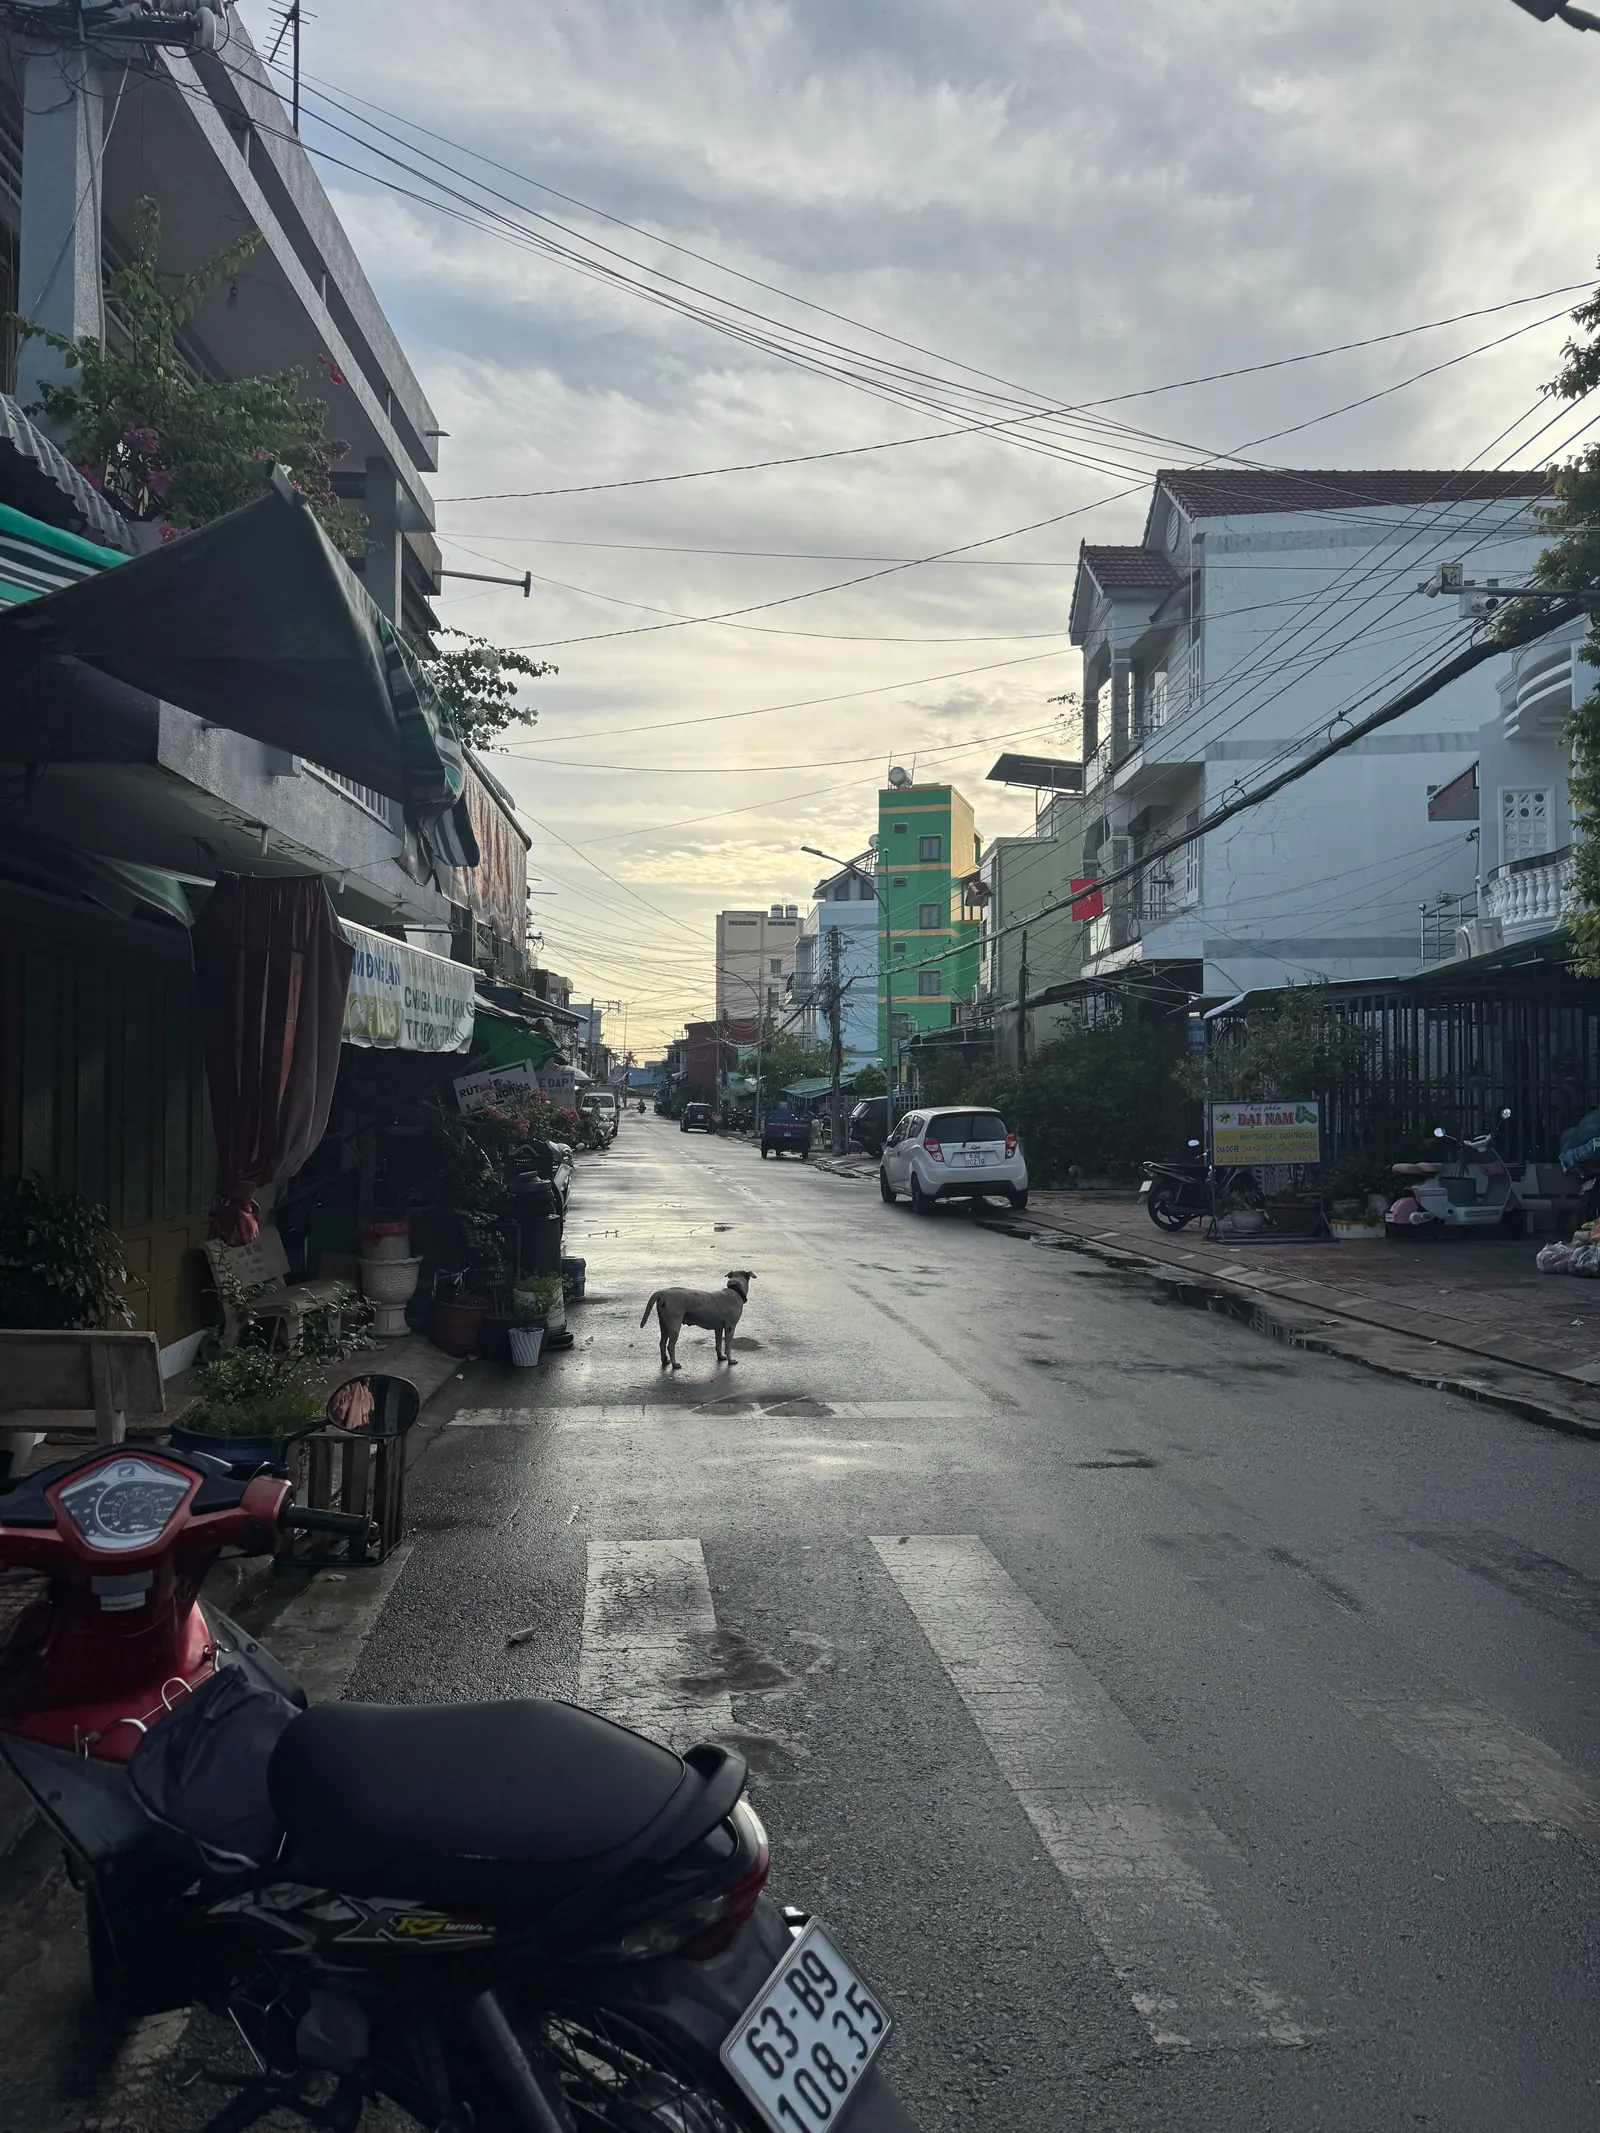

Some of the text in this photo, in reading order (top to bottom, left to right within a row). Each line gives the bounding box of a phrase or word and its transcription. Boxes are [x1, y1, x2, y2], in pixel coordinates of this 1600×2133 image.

[459, 1084, 479, 1098] RÚT
[1265, 1112, 1294, 1125] NAM
[746, 1949, 838, 2080] 63-B9
[777, 1981, 883, 2133] 108.35
